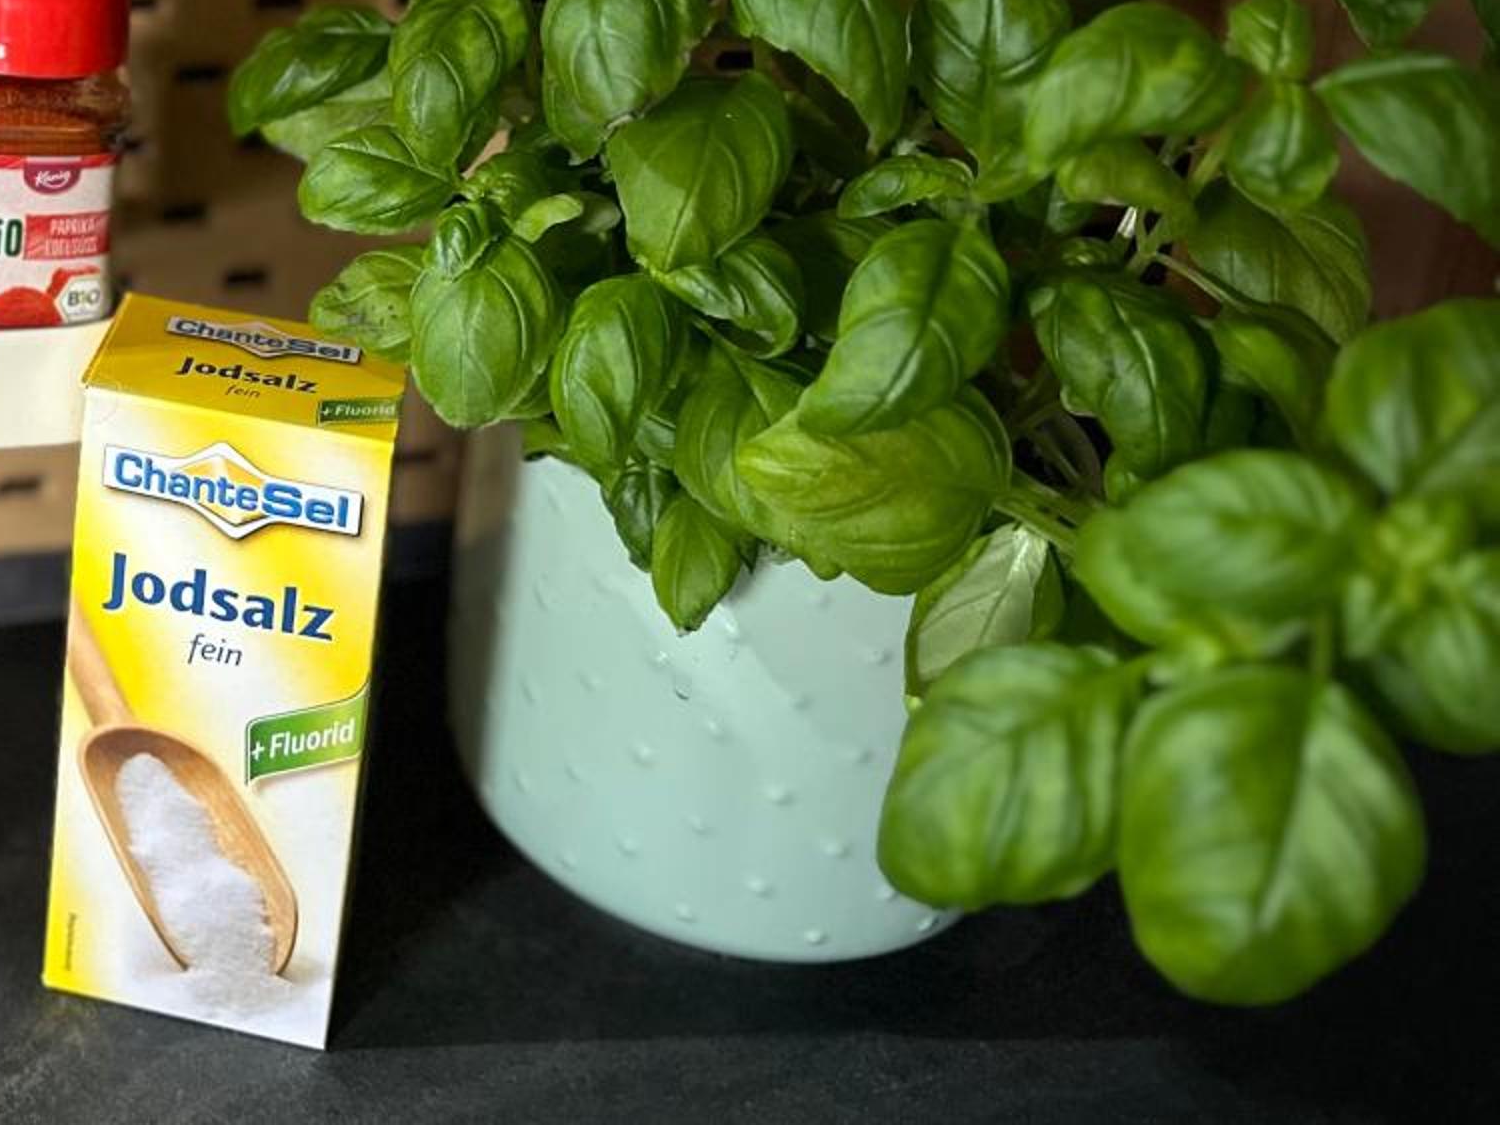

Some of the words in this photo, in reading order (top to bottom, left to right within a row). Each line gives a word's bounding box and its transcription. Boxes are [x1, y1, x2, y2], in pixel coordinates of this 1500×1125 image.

[175, 319, 352, 360] ChanteSel
[176, 356, 319, 394] Jodsalz
[225, 383, 261, 399] fein
[334, 403, 396, 417] Fluorid
[114, 452, 349, 528] ChanteSel
[102, 552, 335, 641] Jodsalz
[187, 633, 243, 666] fein
[270, 718, 355, 760] Fluorid
